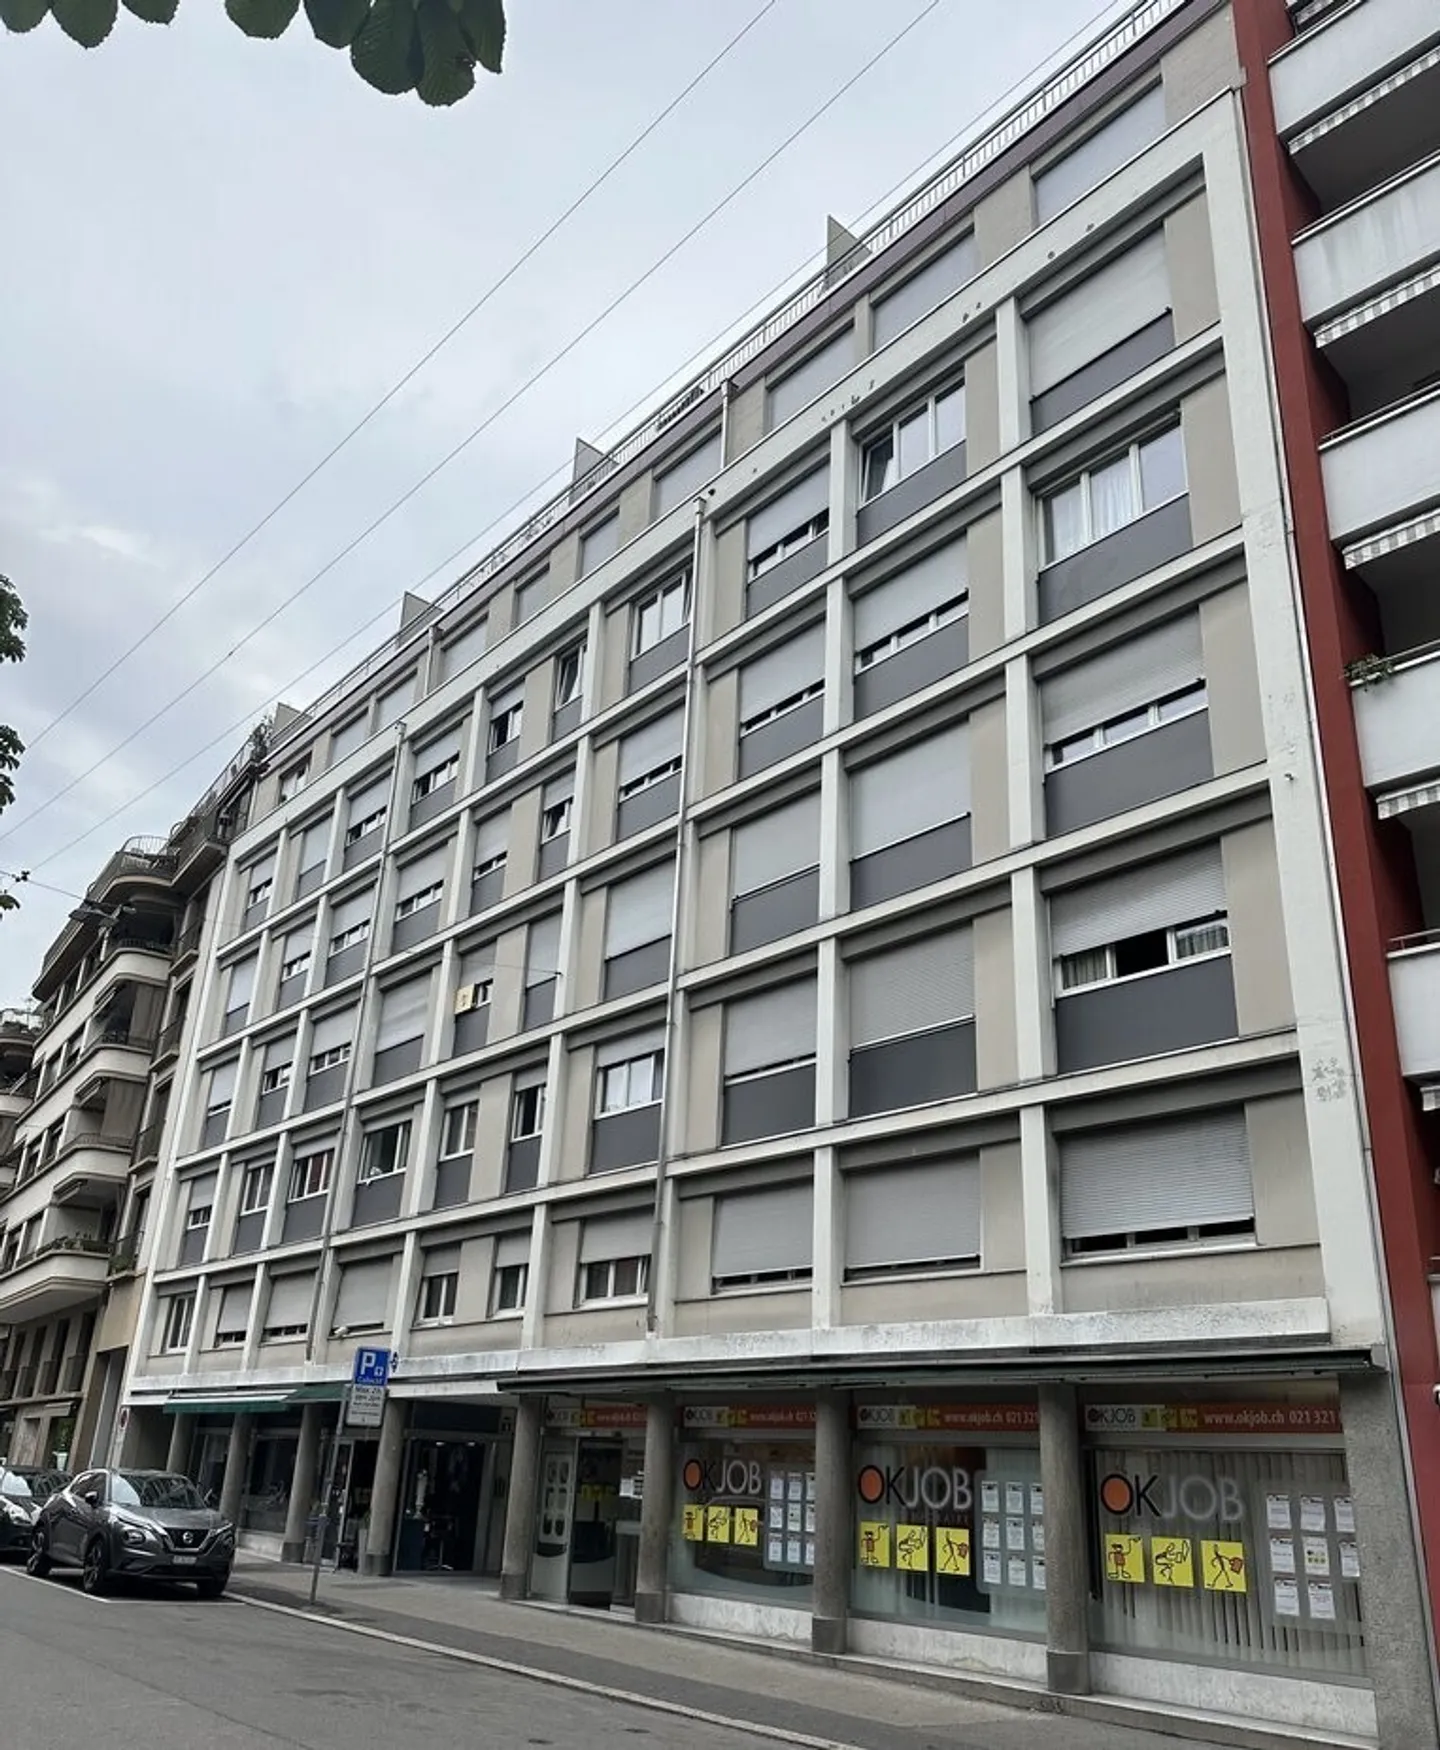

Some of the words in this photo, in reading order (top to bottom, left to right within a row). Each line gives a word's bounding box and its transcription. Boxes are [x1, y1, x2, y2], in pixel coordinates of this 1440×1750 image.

[360, 1351, 377, 1375] P
[1203, 1410, 1285, 1428] www.okjob.ch
[1289, 1410, 1311, 1424] 021
[1313, 1410, 1336, 1425] 321
